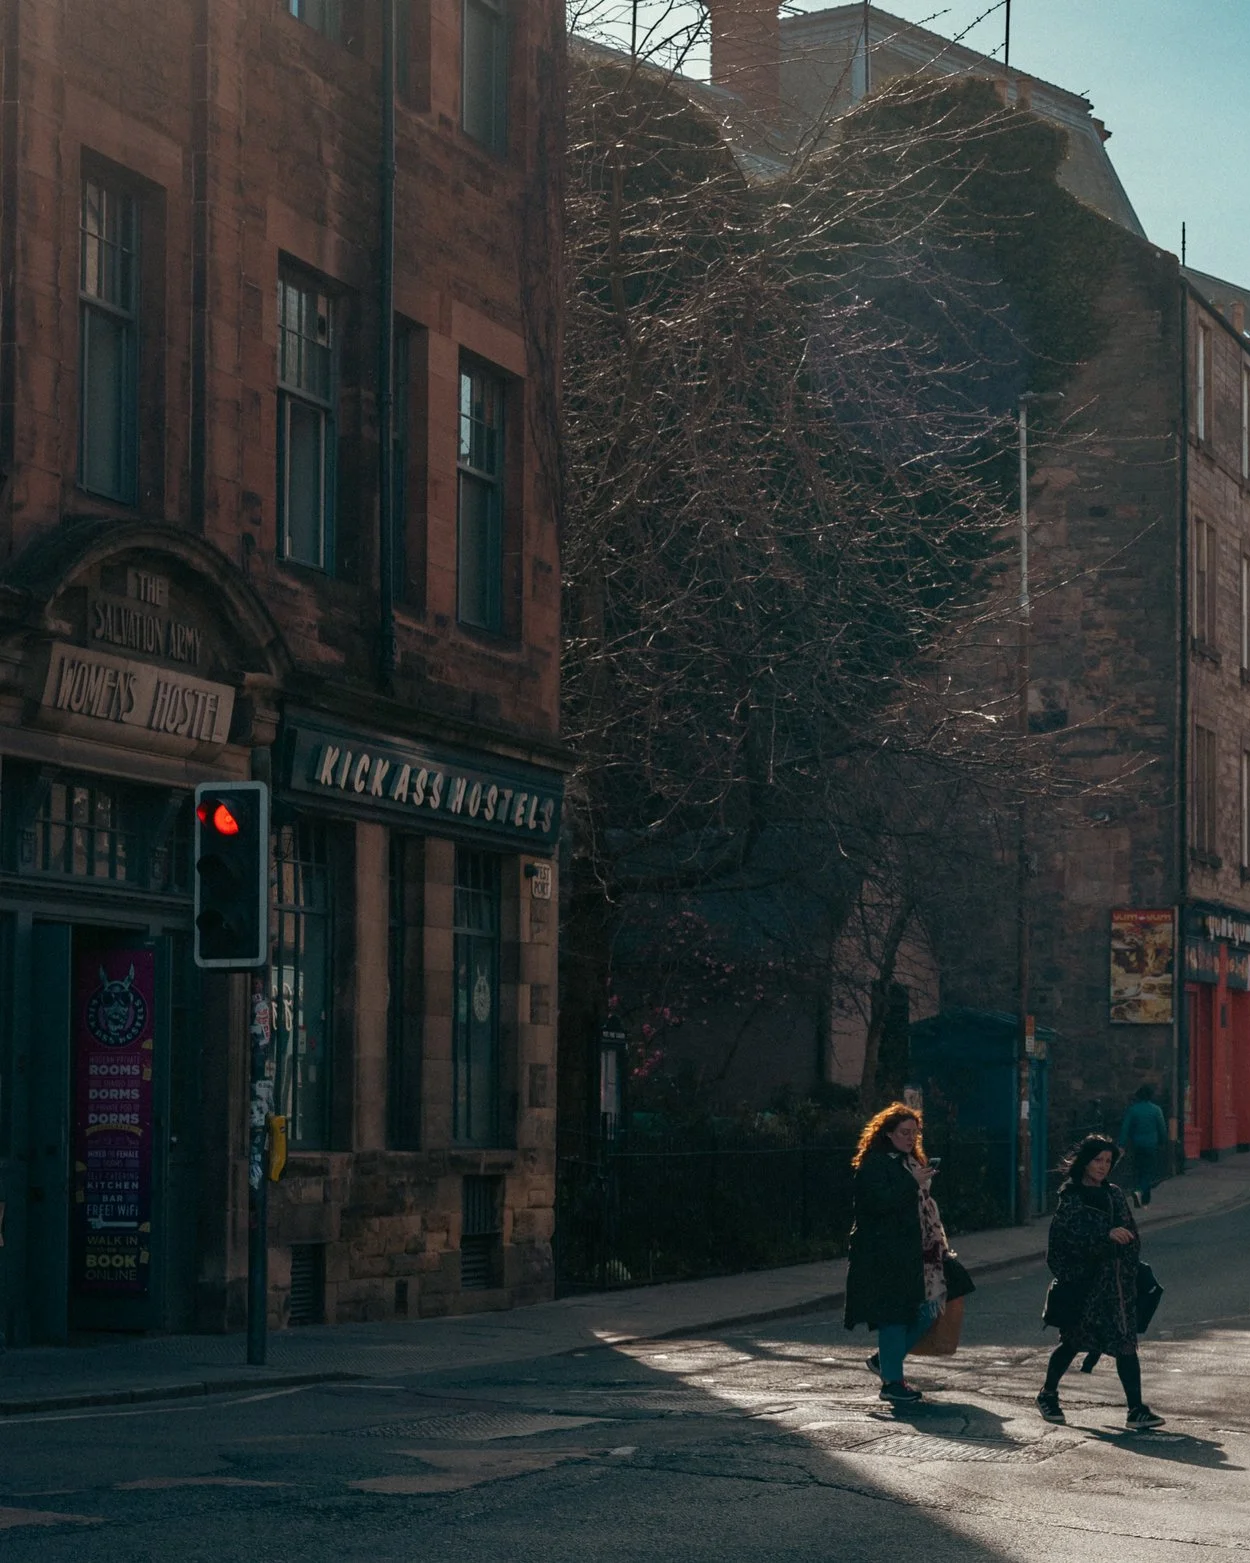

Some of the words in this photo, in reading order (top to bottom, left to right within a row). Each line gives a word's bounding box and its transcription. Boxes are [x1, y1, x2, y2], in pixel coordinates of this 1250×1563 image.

[136, 571, 164, 605] THE
[95, 602, 165, 657] SALVATION
[169, 622, 203, 665] ARMY
[152, 680, 223, 742] HOSTEL
[320, 745, 390, 798] KICK
[393, 764, 444, 810] ASS
[451, 777, 554, 833] HOSTELS
[534, 881, 550, 896] PORT
[89, 1064, 140, 1076] ROOMS
[89, 1089, 140, 1100] DORMS
[88, 1113, 140, 1124] DORMS
[117, 1150, 139, 1158] FEMALE
[87, 1182, 140, 1190] KITCHEN
[102, 1195, 124, 1203] BAR
[87, 1204, 114, 1216] FREE!
[87, 1236, 121, 1246] WALK
[126, 1236, 139, 1246] IN
[85, 1254, 137, 1268] BOOK
[84, 1270, 137, 1281] ONLINE
